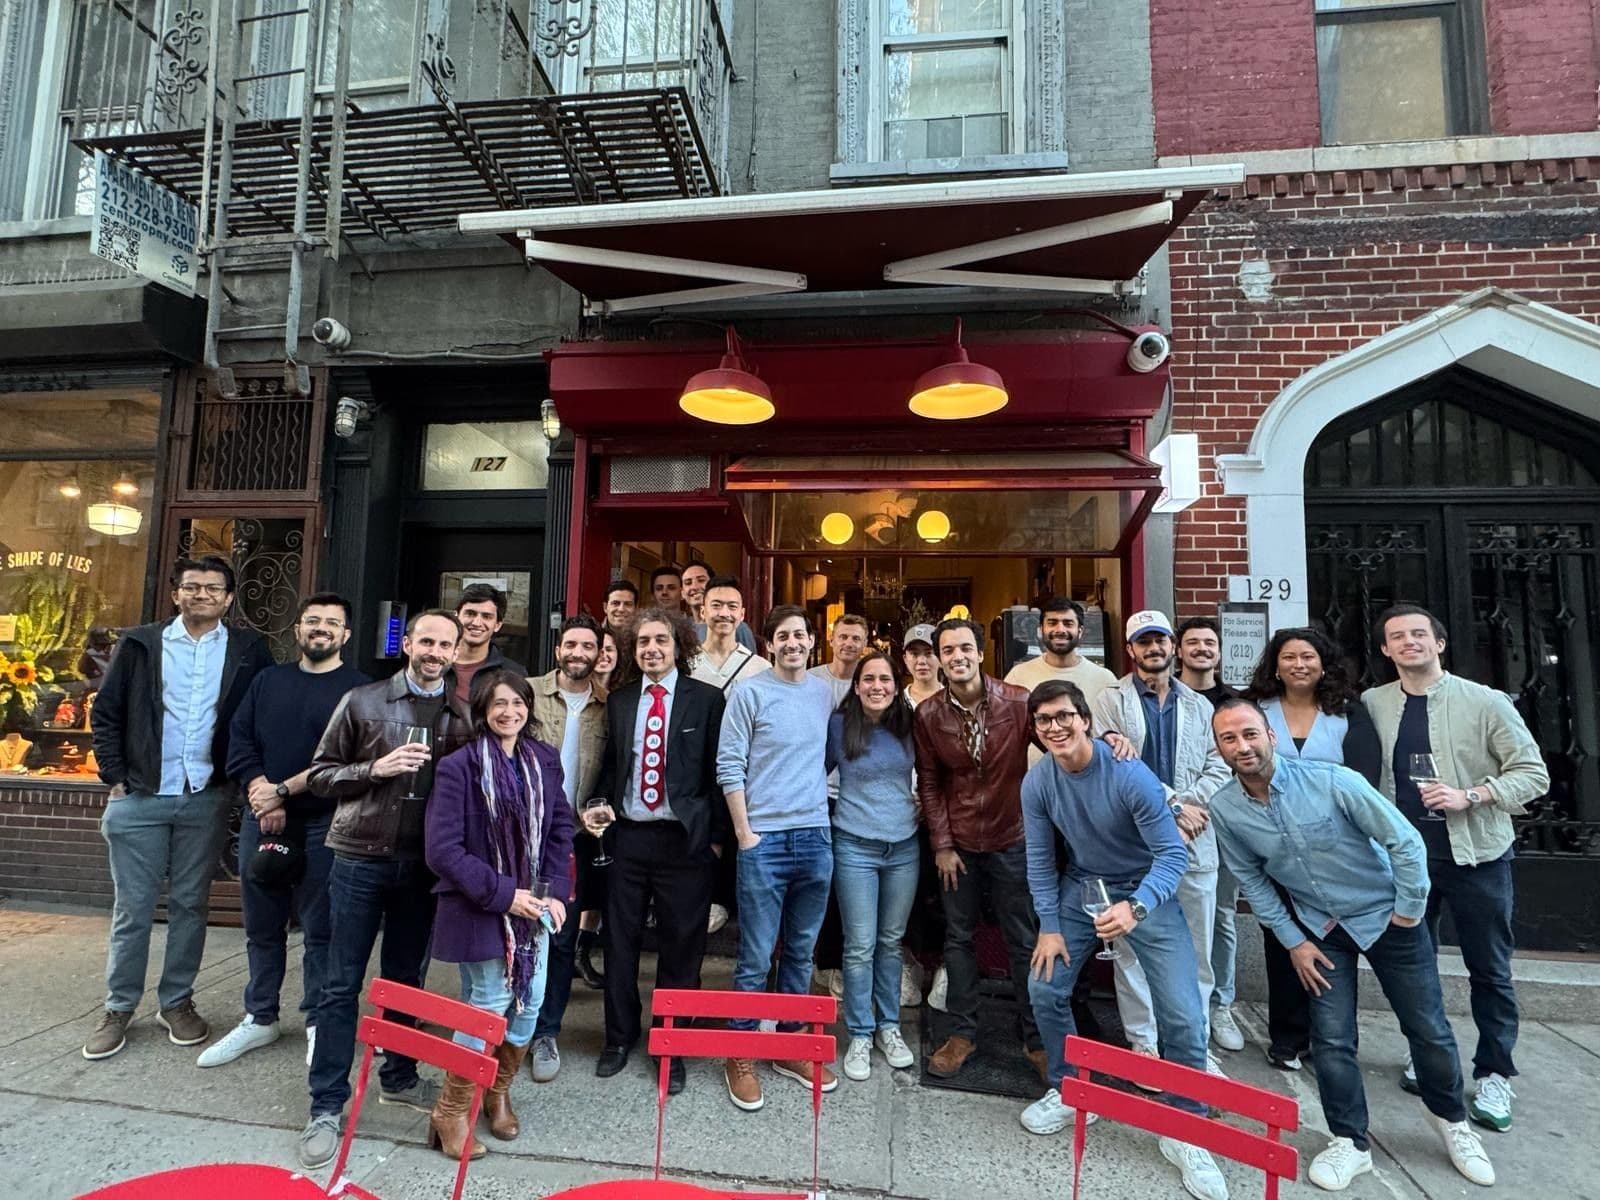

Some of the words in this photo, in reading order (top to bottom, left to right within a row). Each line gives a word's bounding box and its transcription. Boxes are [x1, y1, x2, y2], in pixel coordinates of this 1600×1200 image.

[100, 158, 155, 205] APARTMENT
[156, 188, 175, 217] FOR
[176, 198, 196, 228] RENT
[101, 181, 196, 245] 212-228-9300
[101, 202, 194, 255] centpropny.com
[473, 456, 507, 471] 127
[8, 551, 44, 568] SHAPE
[49, 552, 64, 566] OF
[67, 555, 92, 573] LIES
[1246, 578, 1292, 601] 129
[1223, 617, 1235, 625] For
[1236, 617, 1264, 626] Service
[1223, 628, 1248, 638] Please
[1249, 628, 1263, 638] call
[1230, 644, 1254, 661] (212)
